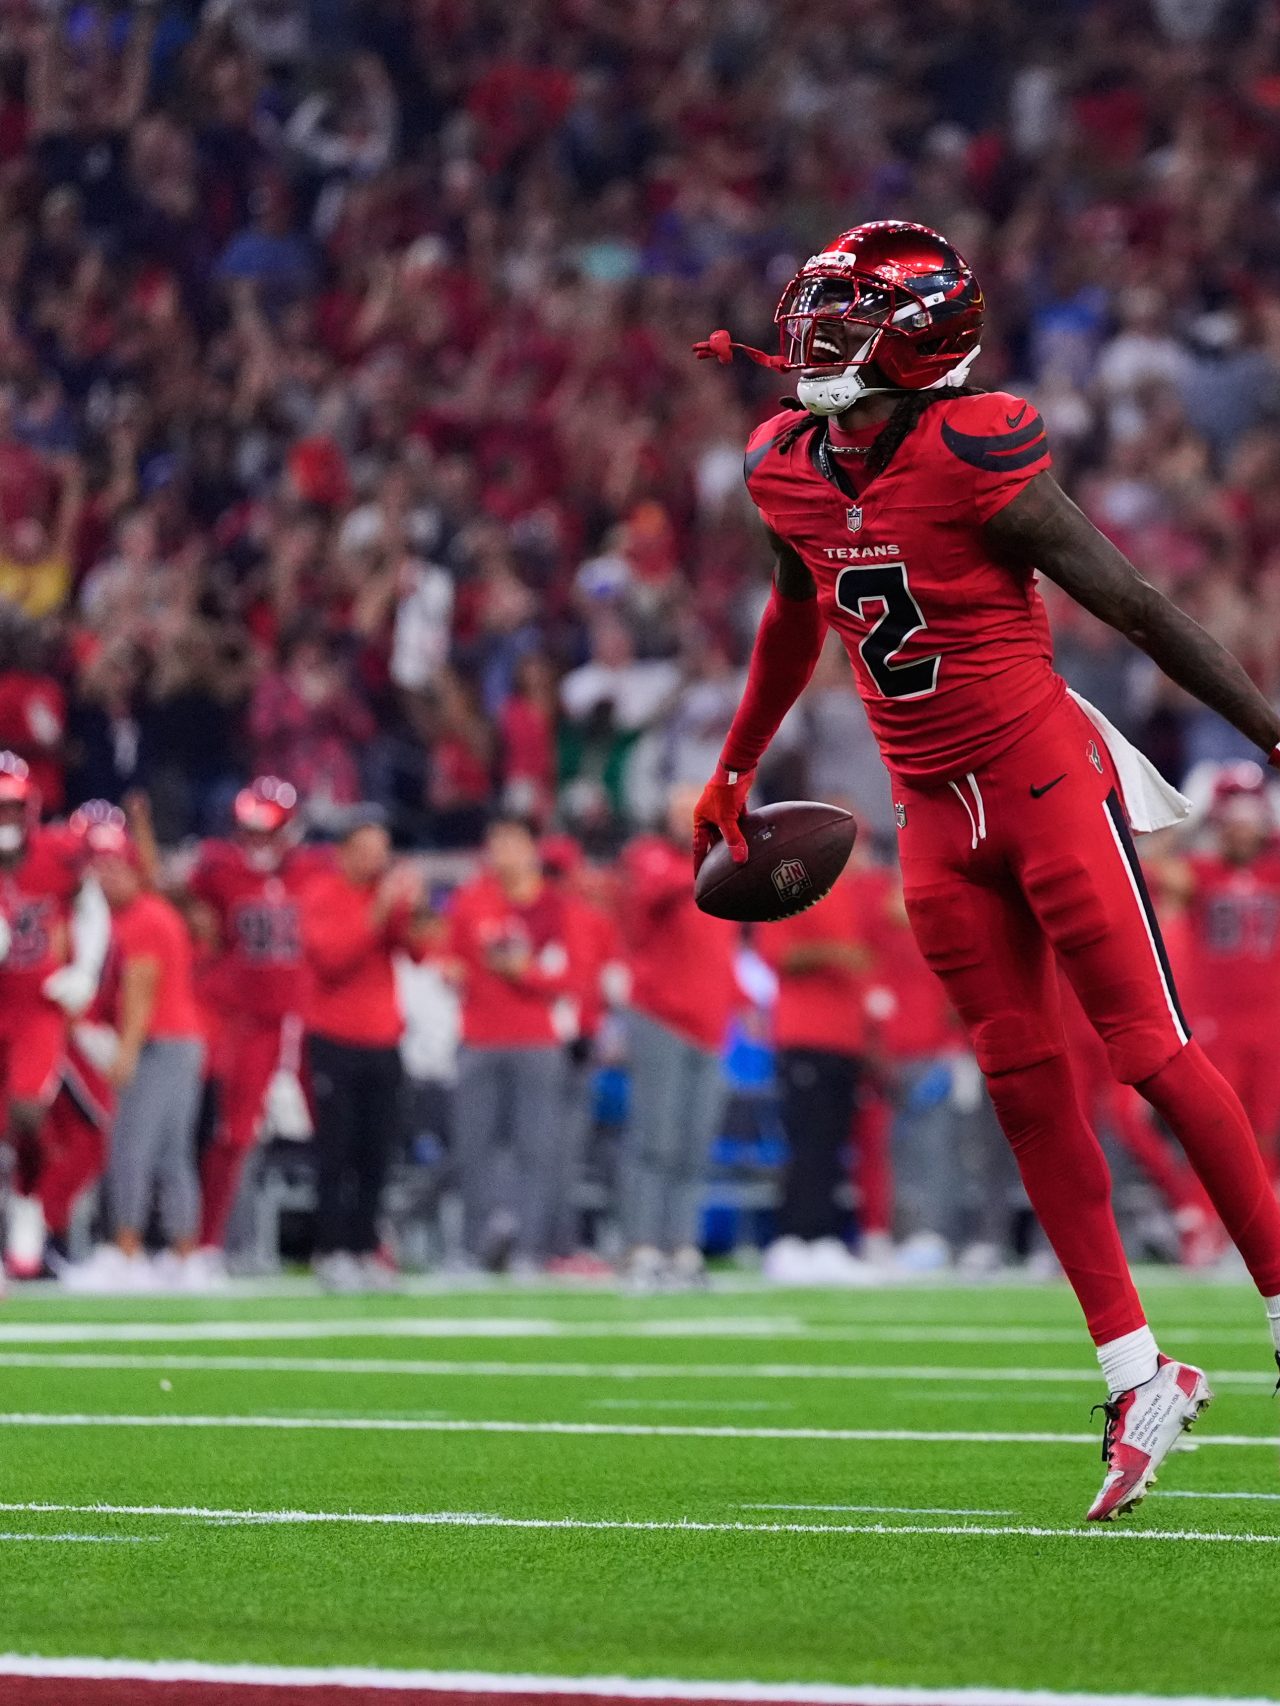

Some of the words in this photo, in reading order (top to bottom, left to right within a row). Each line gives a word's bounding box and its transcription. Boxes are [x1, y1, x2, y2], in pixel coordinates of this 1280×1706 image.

[823, 544, 900, 559] TEXANS
[835, 562, 941, 700] 2
[776, 863, 804, 887] NFL
